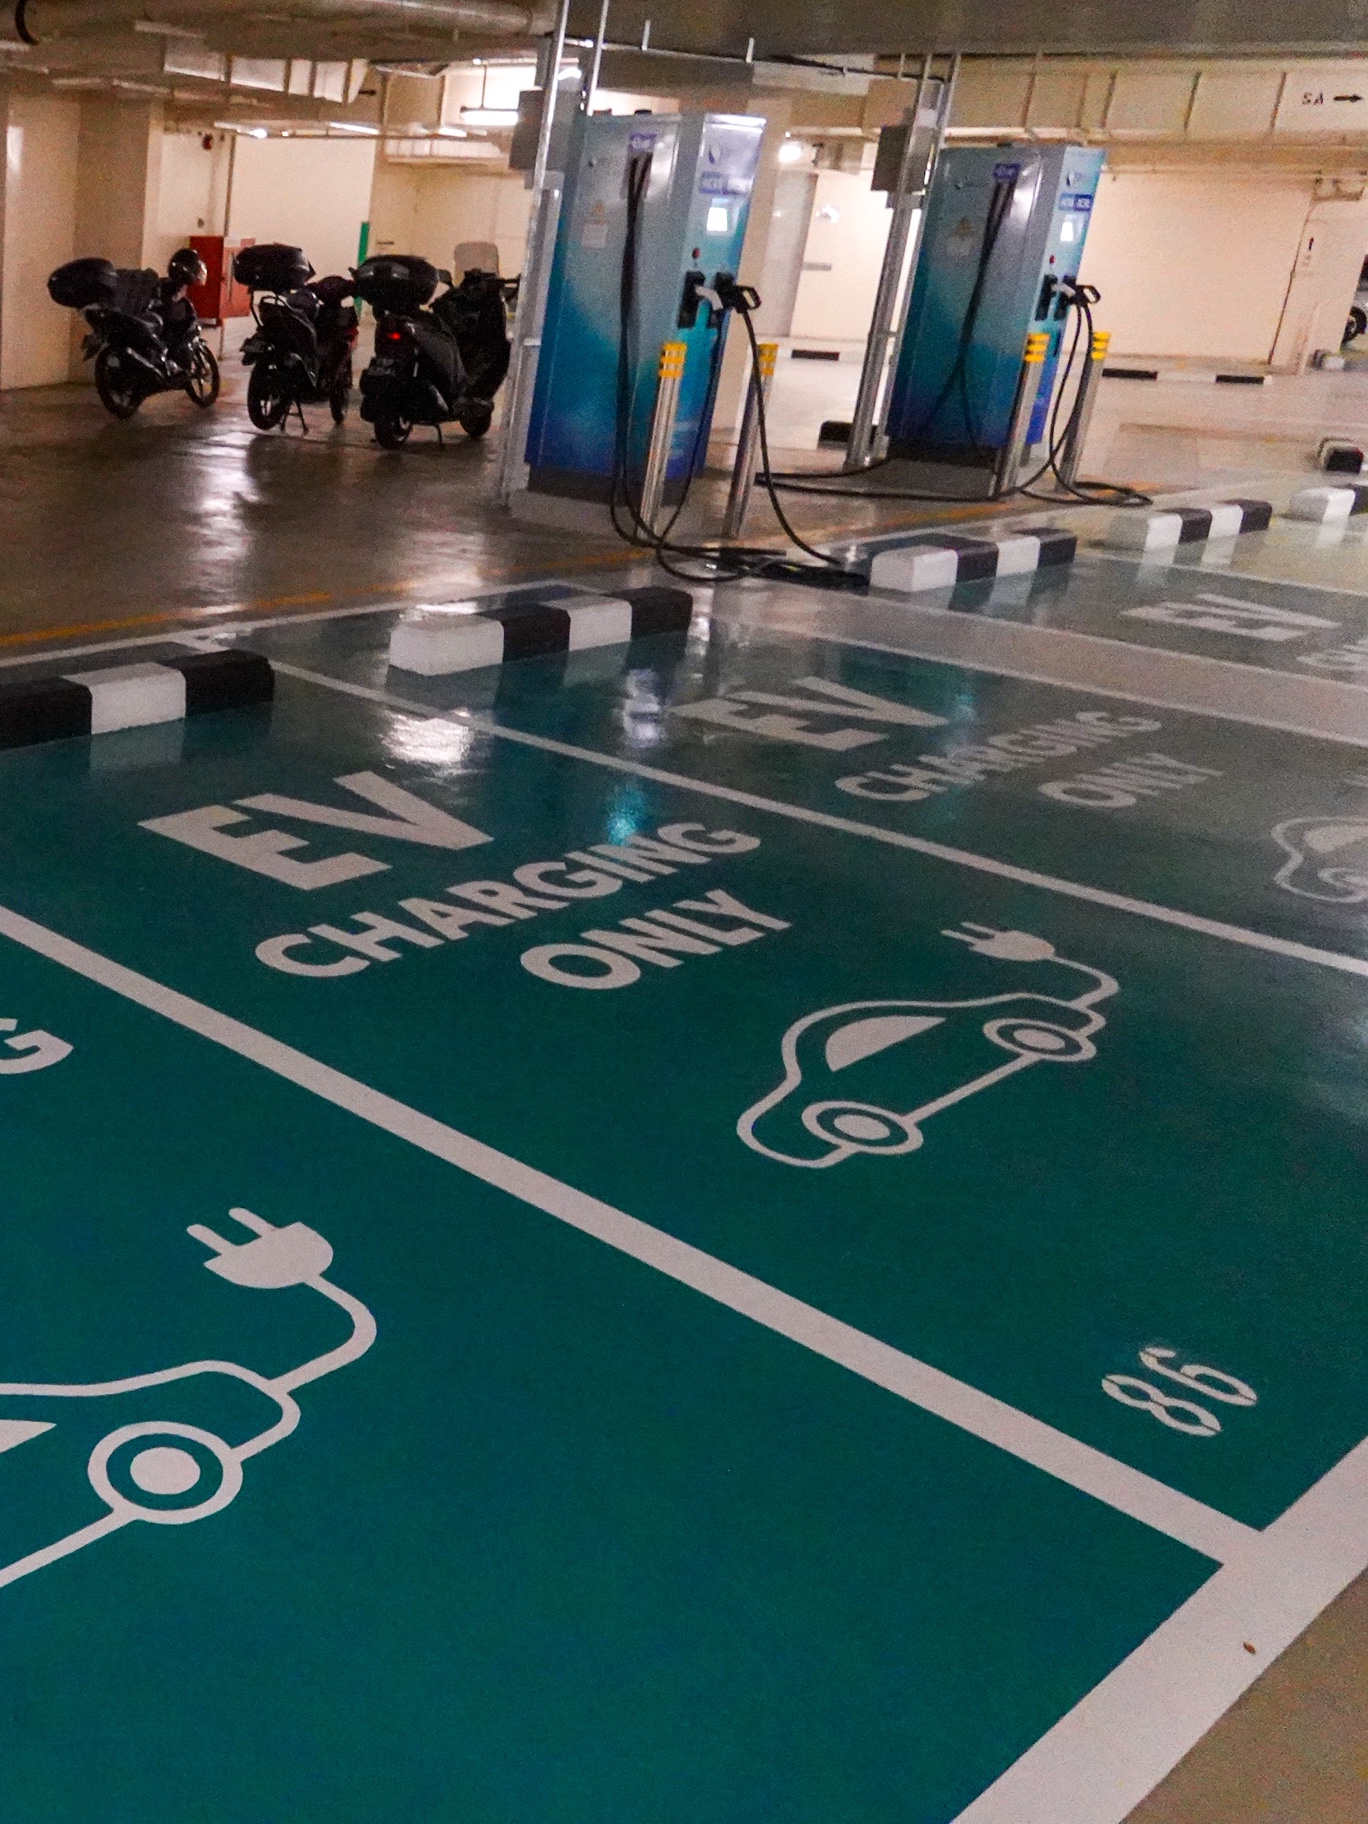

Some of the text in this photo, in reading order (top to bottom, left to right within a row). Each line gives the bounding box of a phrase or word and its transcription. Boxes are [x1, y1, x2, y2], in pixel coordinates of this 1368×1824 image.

[1121, 592, 1343, 642] EV
[668, 675, 950, 751] EV
[835, 711, 1162, 800] CHARGING
[1038, 752, 1223, 807] ONLY
[138, 771, 494, 891] EV
[255, 822, 761, 977] CHARGING
[520, 889, 792, 989] ONLY
[1101, 1347, 1258, 1437] 86
